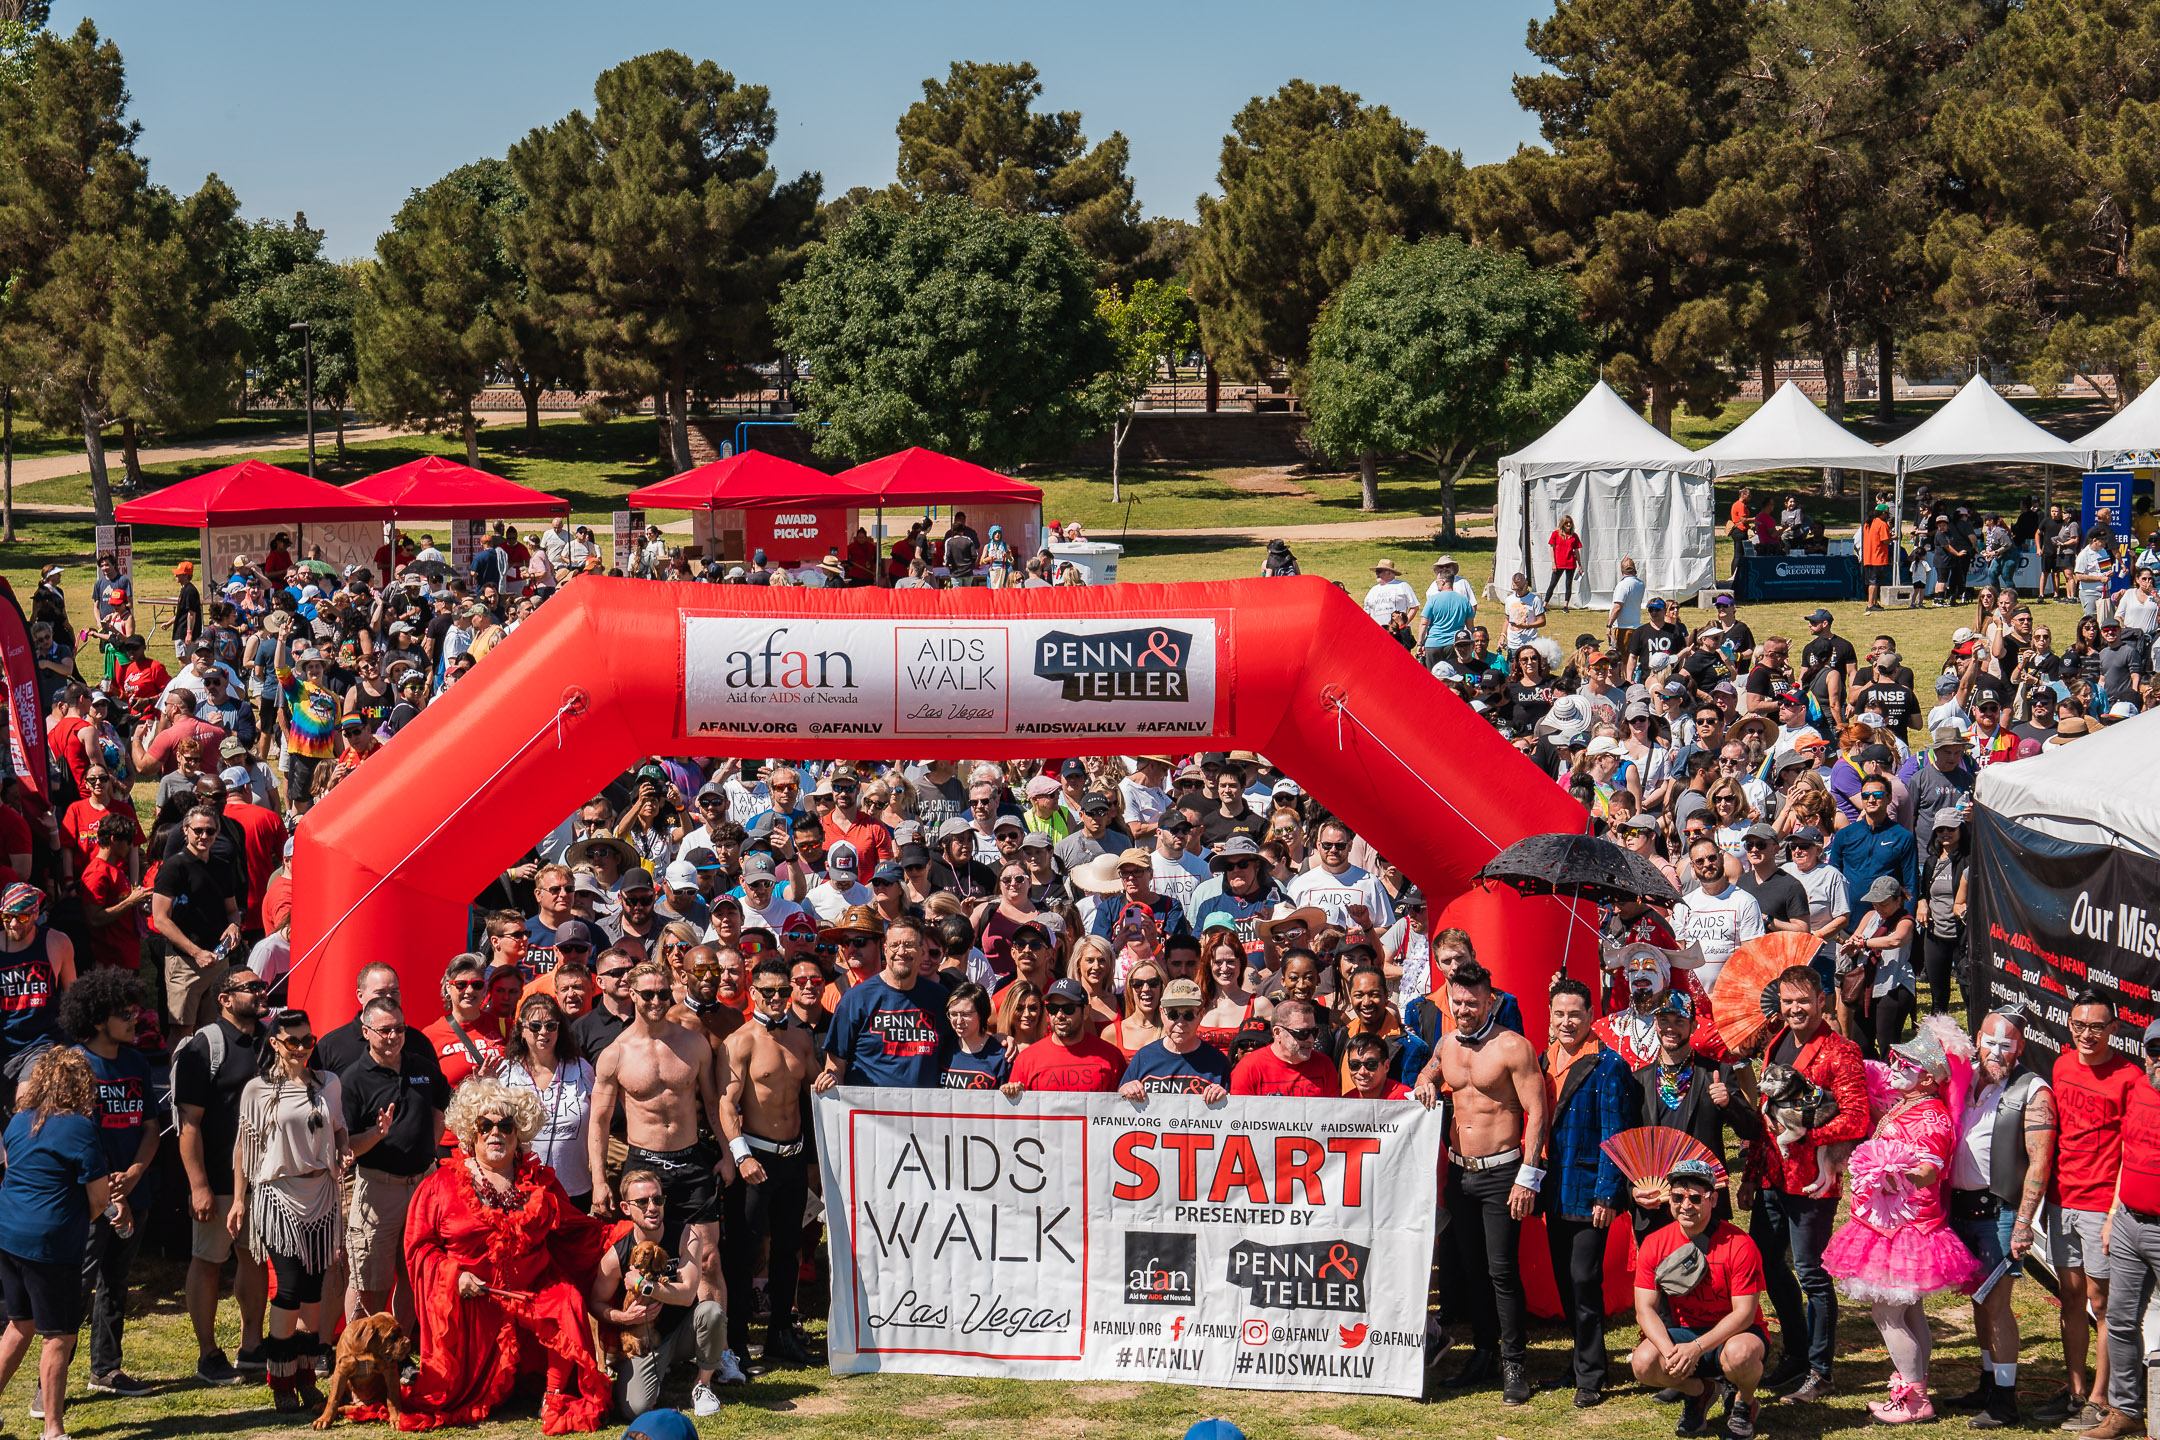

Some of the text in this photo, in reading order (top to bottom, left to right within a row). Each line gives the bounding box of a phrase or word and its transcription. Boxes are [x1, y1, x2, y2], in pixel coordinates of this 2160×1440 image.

[775, 514, 817, 525] AWARD
[457, 537, 480, 546] WALER
[774, 528, 819, 539] PICK-UP
[918, 638, 985, 662] AIDS
[1648, 637, 1672, 651] NO
[726, 628, 859, 689] afan
[1043, 642, 1132, 667] PENN
[907, 665, 997, 691] WALK
[1074, 672, 1182, 696] TELLER
[726, 691, 859, 704] Aid for AIDS of Nevada
[906, 703, 995, 720] Las Vegas
[698, 721, 883, 734] AFANLV.ORG @AFANLV
[1014, 721, 1207, 734] #AIDSWALKLV #AFANLV
[932, 799, 961, 812] CAREFU
[1164, 881, 1193, 893] AIDS
[1319, 893, 1352, 905] AIDS
[1692, 916, 1725, 929] AIDS
[2070, 890, 2113, 943] Our
[1687, 928, 1730, 941] WALK
[1993, 951, 2005, 969] for
[2022, 968, 2041, 985] and
[2010, 932, 2032, 953] AIDS
[2060, 954, 2087, 981] (AFAN)
[2087, 966, 2119, 990] provides
[2119, 978, 2151, 1000] support
[875, 1014, 915, 1028] PENN
[2045, 1005, 2069, 1027] AFAN
[2118, 1005, 2149, 1029] affected
[889, 1028, 936, 1042] TELLER
[2024, 1024, 2053, 1049] ducation
[442, 1039, 487, 1056] GRB
[2125, 1036, 2140, 1055] HIV
[940, 1072, 968, 1089] ENN
[1046, 1069, 1094, 1088] AIDS
[1144, 1081, 1183, 1094] PENN
[106, 1100, 144, 1113] TELLER
[2059, 1088, 2096, 1112] AIDS
[1092, 1116, 1399, 1133] AFANLV.ORG @AFANLV @AIDSWALKLV #AIDSWALKLV
[887, 1133, 1047, 1194] AIDS
[1112, 1130, 1381, 1207] START
[1175, 1206, 1315, 1226] PRESENTED BY
[864, 1200, 1076, 1264] WALK
[1129, 1257, 1191, 1291] afan
[1235, 1251, 1315, 1279] PENN
[1129, 1292, 1139, 1300] Aid
[1139, 1292, 1148, 1300] for
[1163, 1293, 1169, 1301] of
[1170, 1293, 1191, 1301] Nevada
[1261, 1280, 1360, 1307] TELLER
[1686, 1287, 1728, 1302] ALK
[868, 1290, 1071, 1337] Las Vegas
[1093, 1320, 1162, 1336] AFANLV.ORG
[1271, 1326, 1329, 1342] @AFANLV
[1116, 1347, 1375, 1378] #AFANLV #AIDSWALKLV
